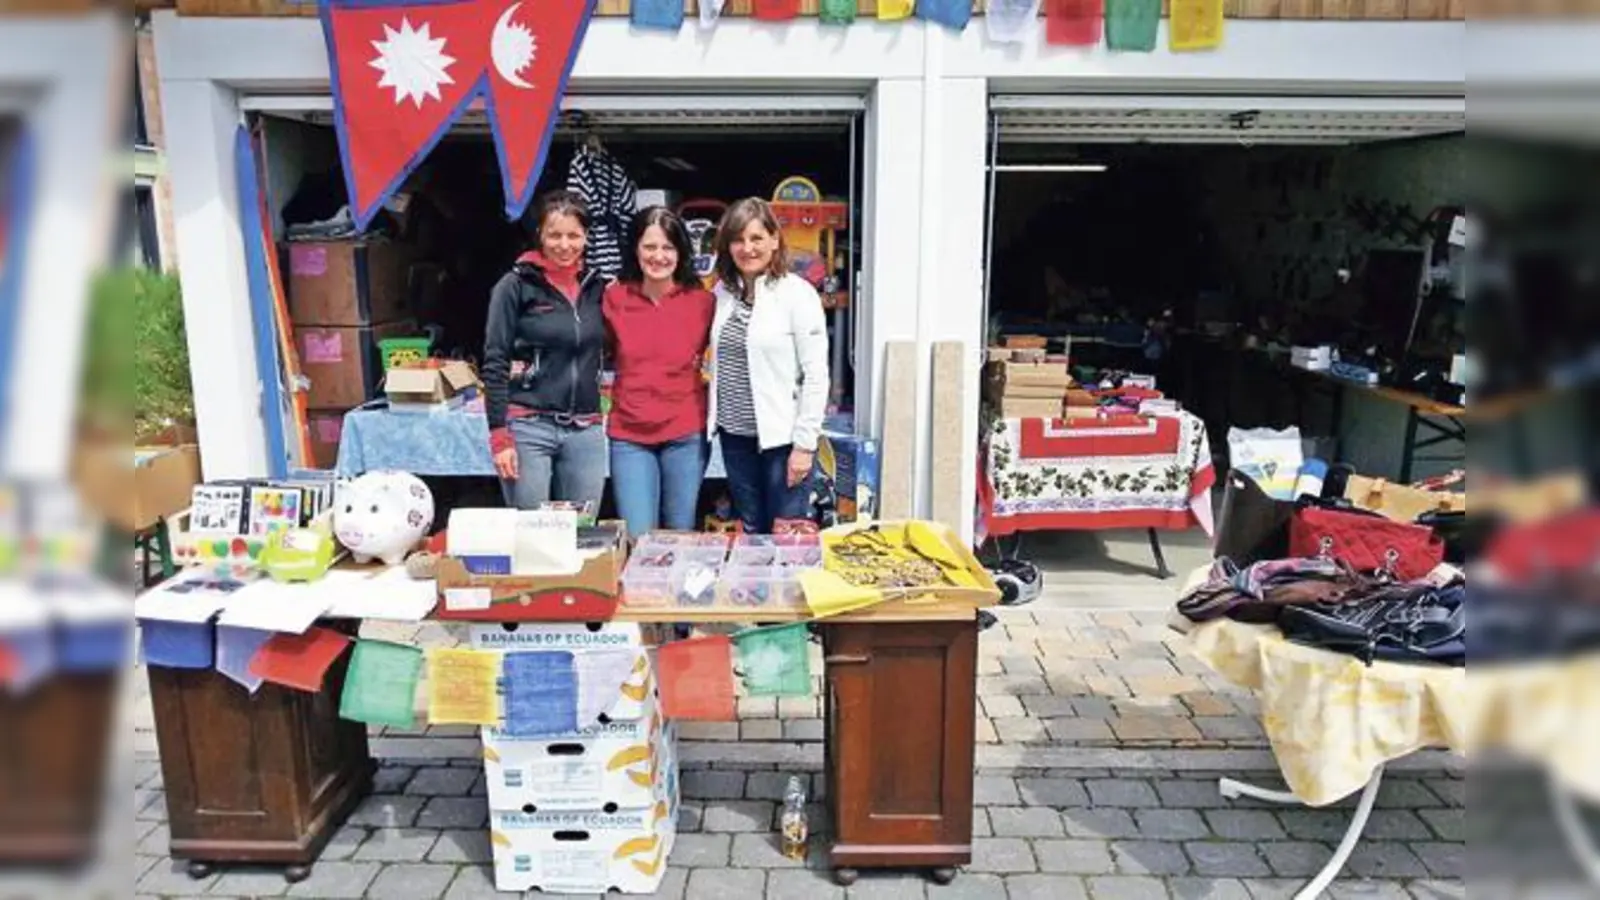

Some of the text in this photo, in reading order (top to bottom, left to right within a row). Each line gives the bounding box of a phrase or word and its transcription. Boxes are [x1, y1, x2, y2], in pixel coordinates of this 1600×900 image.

[480, 633, 628, 645] BANANAS OF ECUADOR
[500, 812, 643, 825] BANANAS OF ECUADOR
